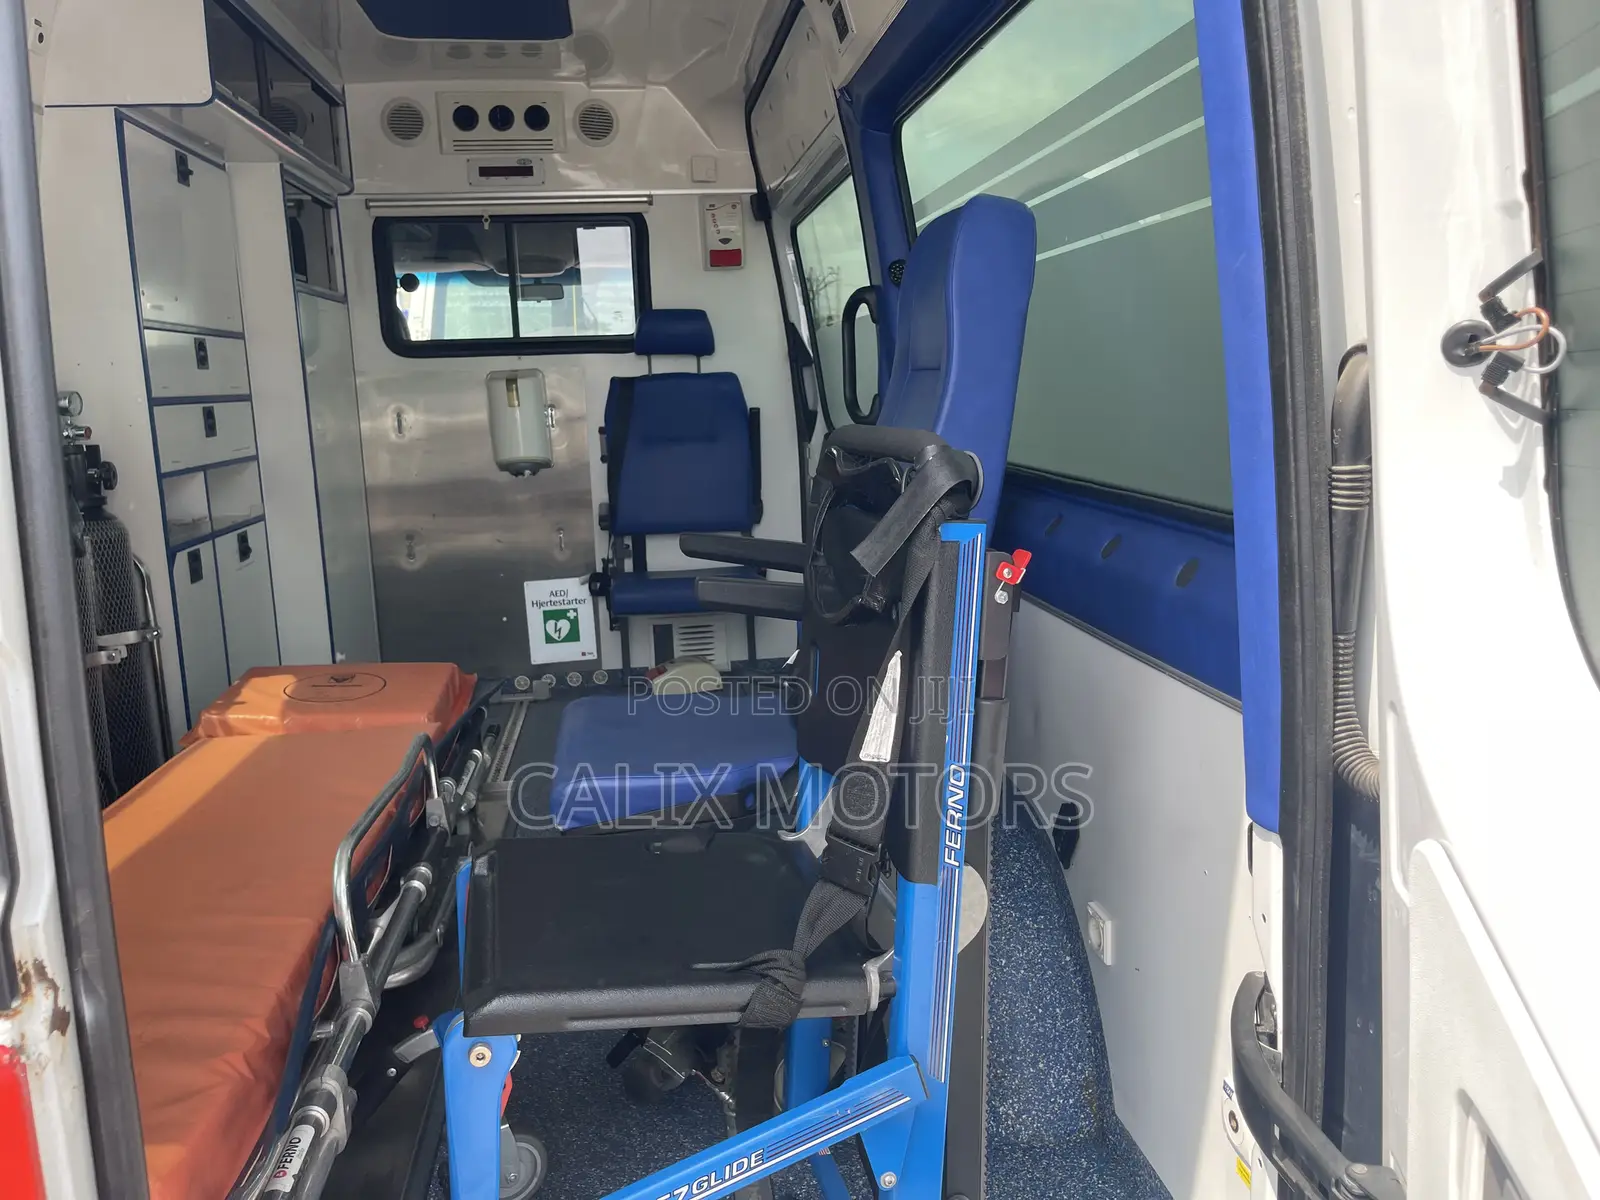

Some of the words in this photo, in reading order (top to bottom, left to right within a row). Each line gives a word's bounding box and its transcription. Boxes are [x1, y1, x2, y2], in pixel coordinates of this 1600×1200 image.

[531, 597, 587, 609] Hjertestarter
[944, 764, 965, 867] FERNO
[277, 1137, 302, 1170] FERNO
